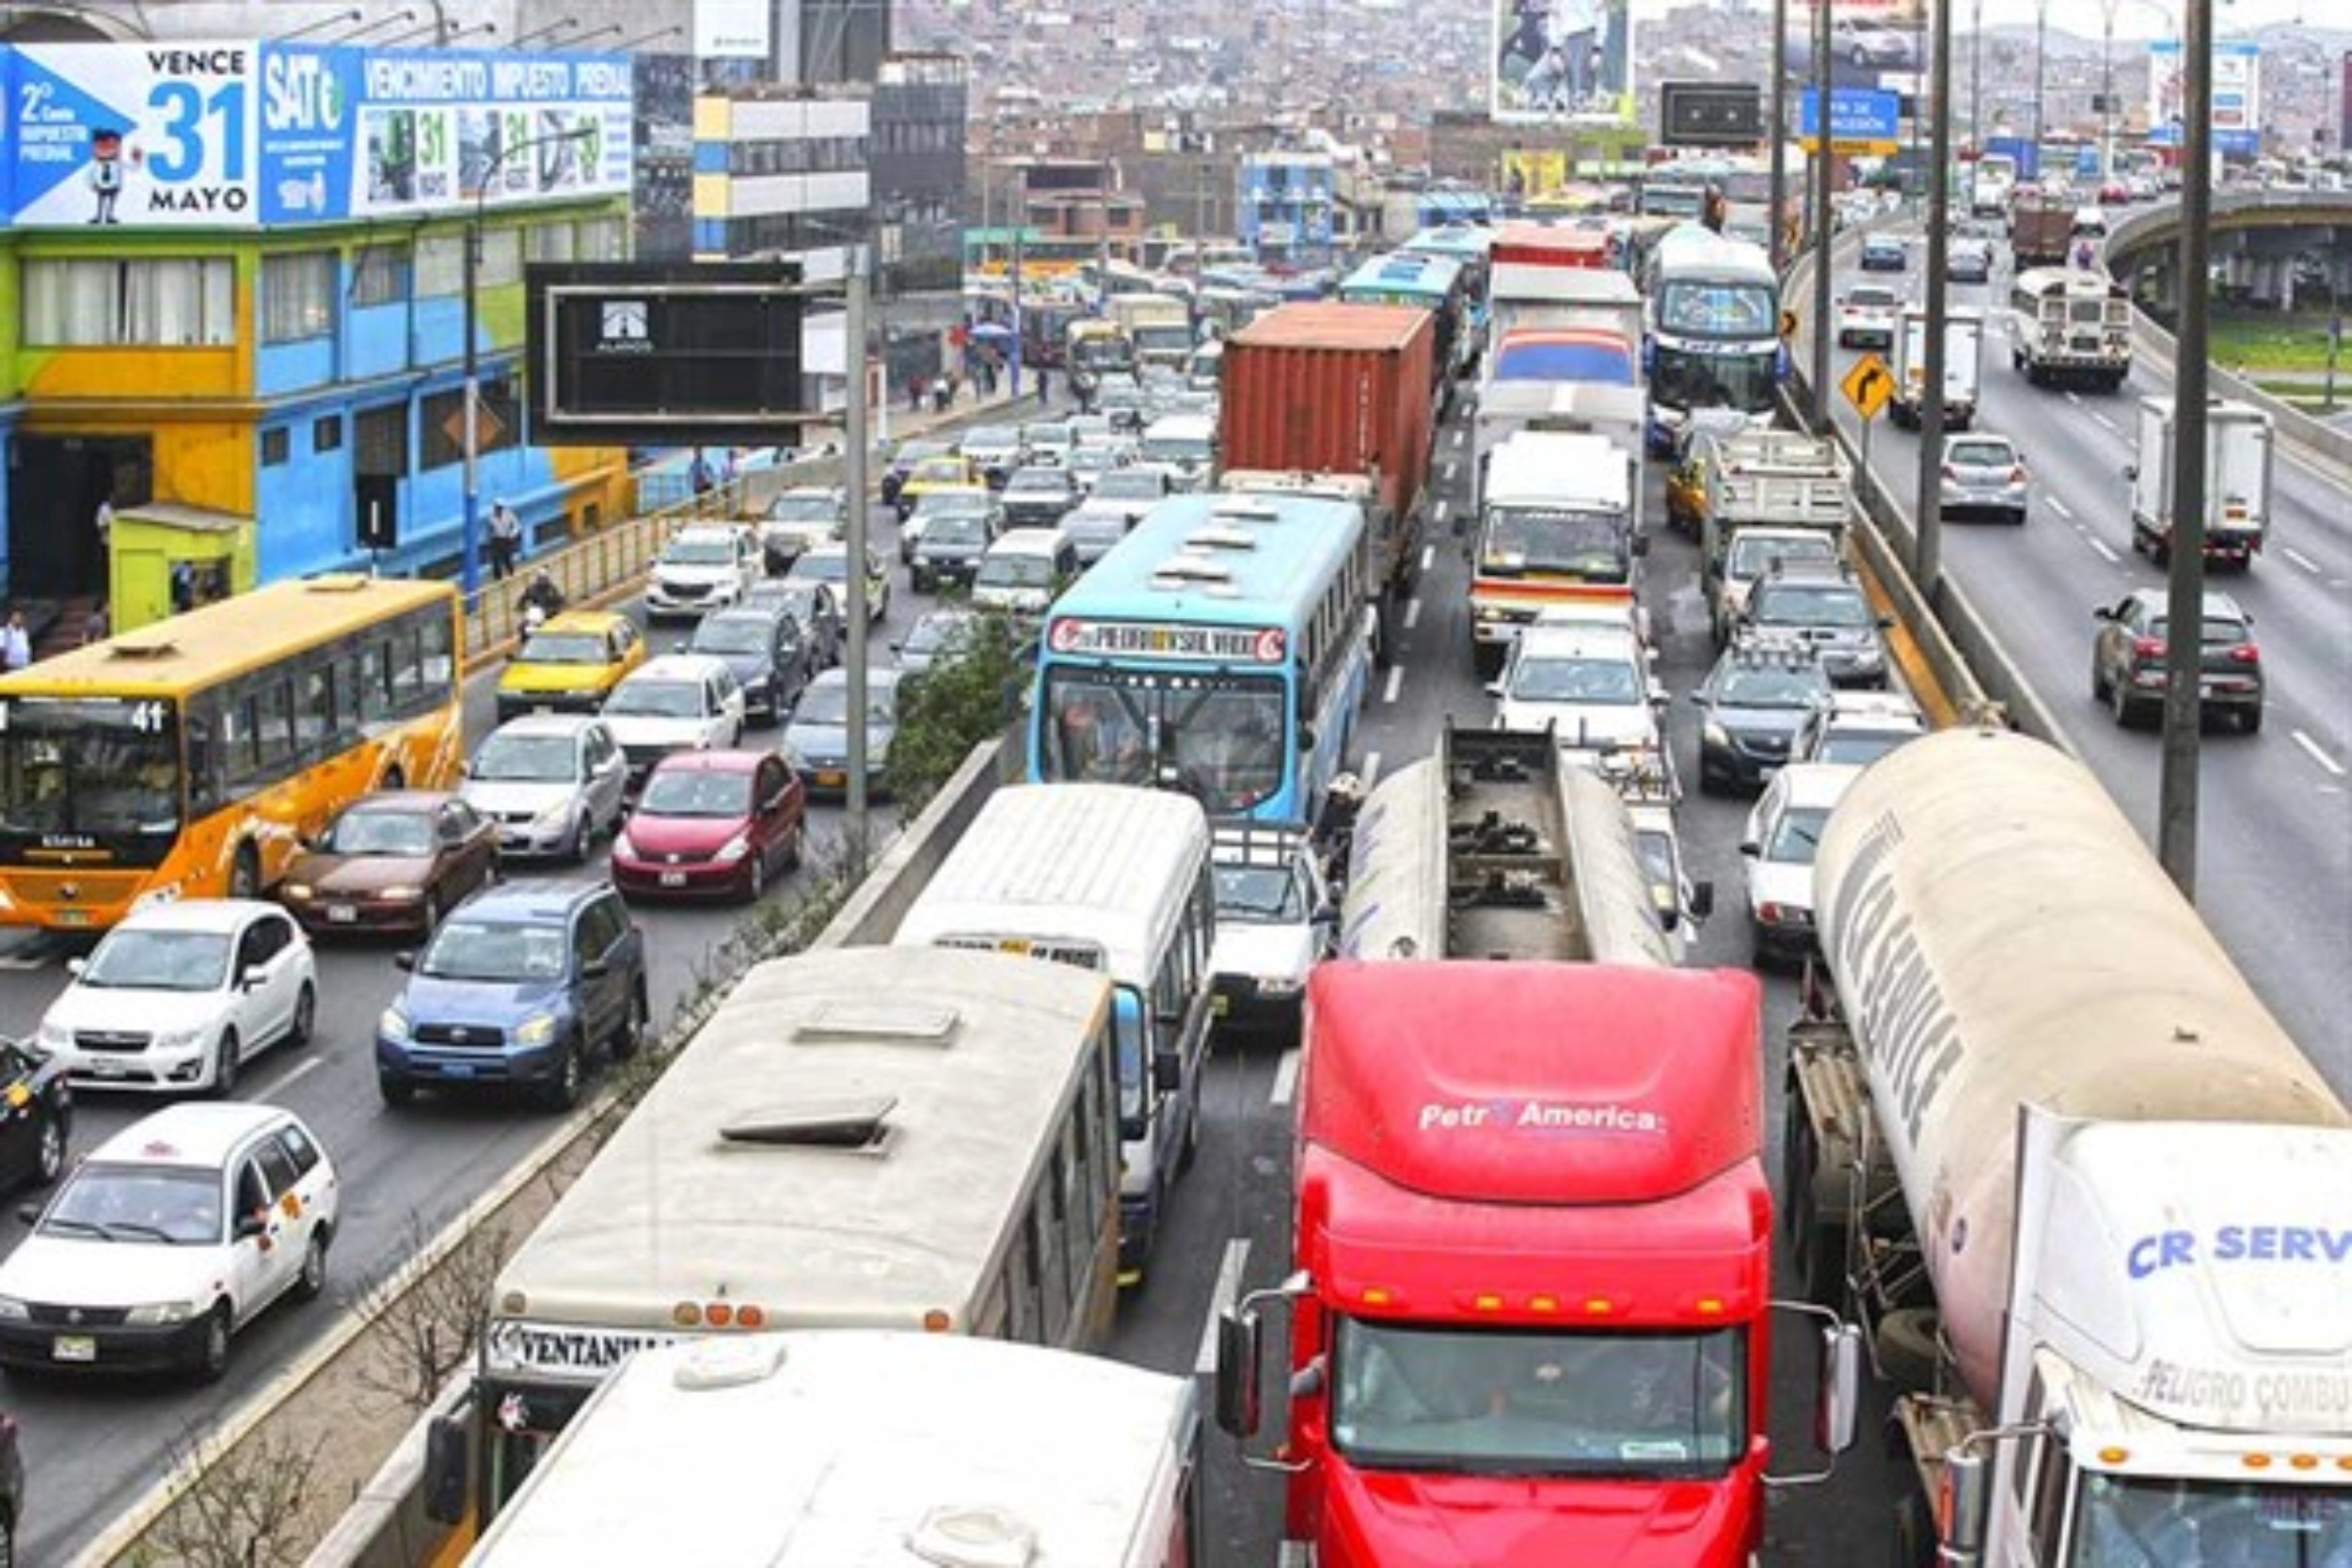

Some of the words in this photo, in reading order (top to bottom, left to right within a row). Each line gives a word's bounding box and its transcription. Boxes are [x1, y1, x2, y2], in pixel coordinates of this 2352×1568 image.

[147, 50, 246, 74] VENCE
[147, 81, 246, 182] 31
[420, 111, 444, 166] 31
[147, 187, 248, 213] MAYO
[2127, 1230, 2195, 1280] CR
[2213, 1226, 2352, 1263] SERV
[520, 1331, 675, 1367] VENTAN
[2139, 1360, 2247, 1407] PELIGRO
